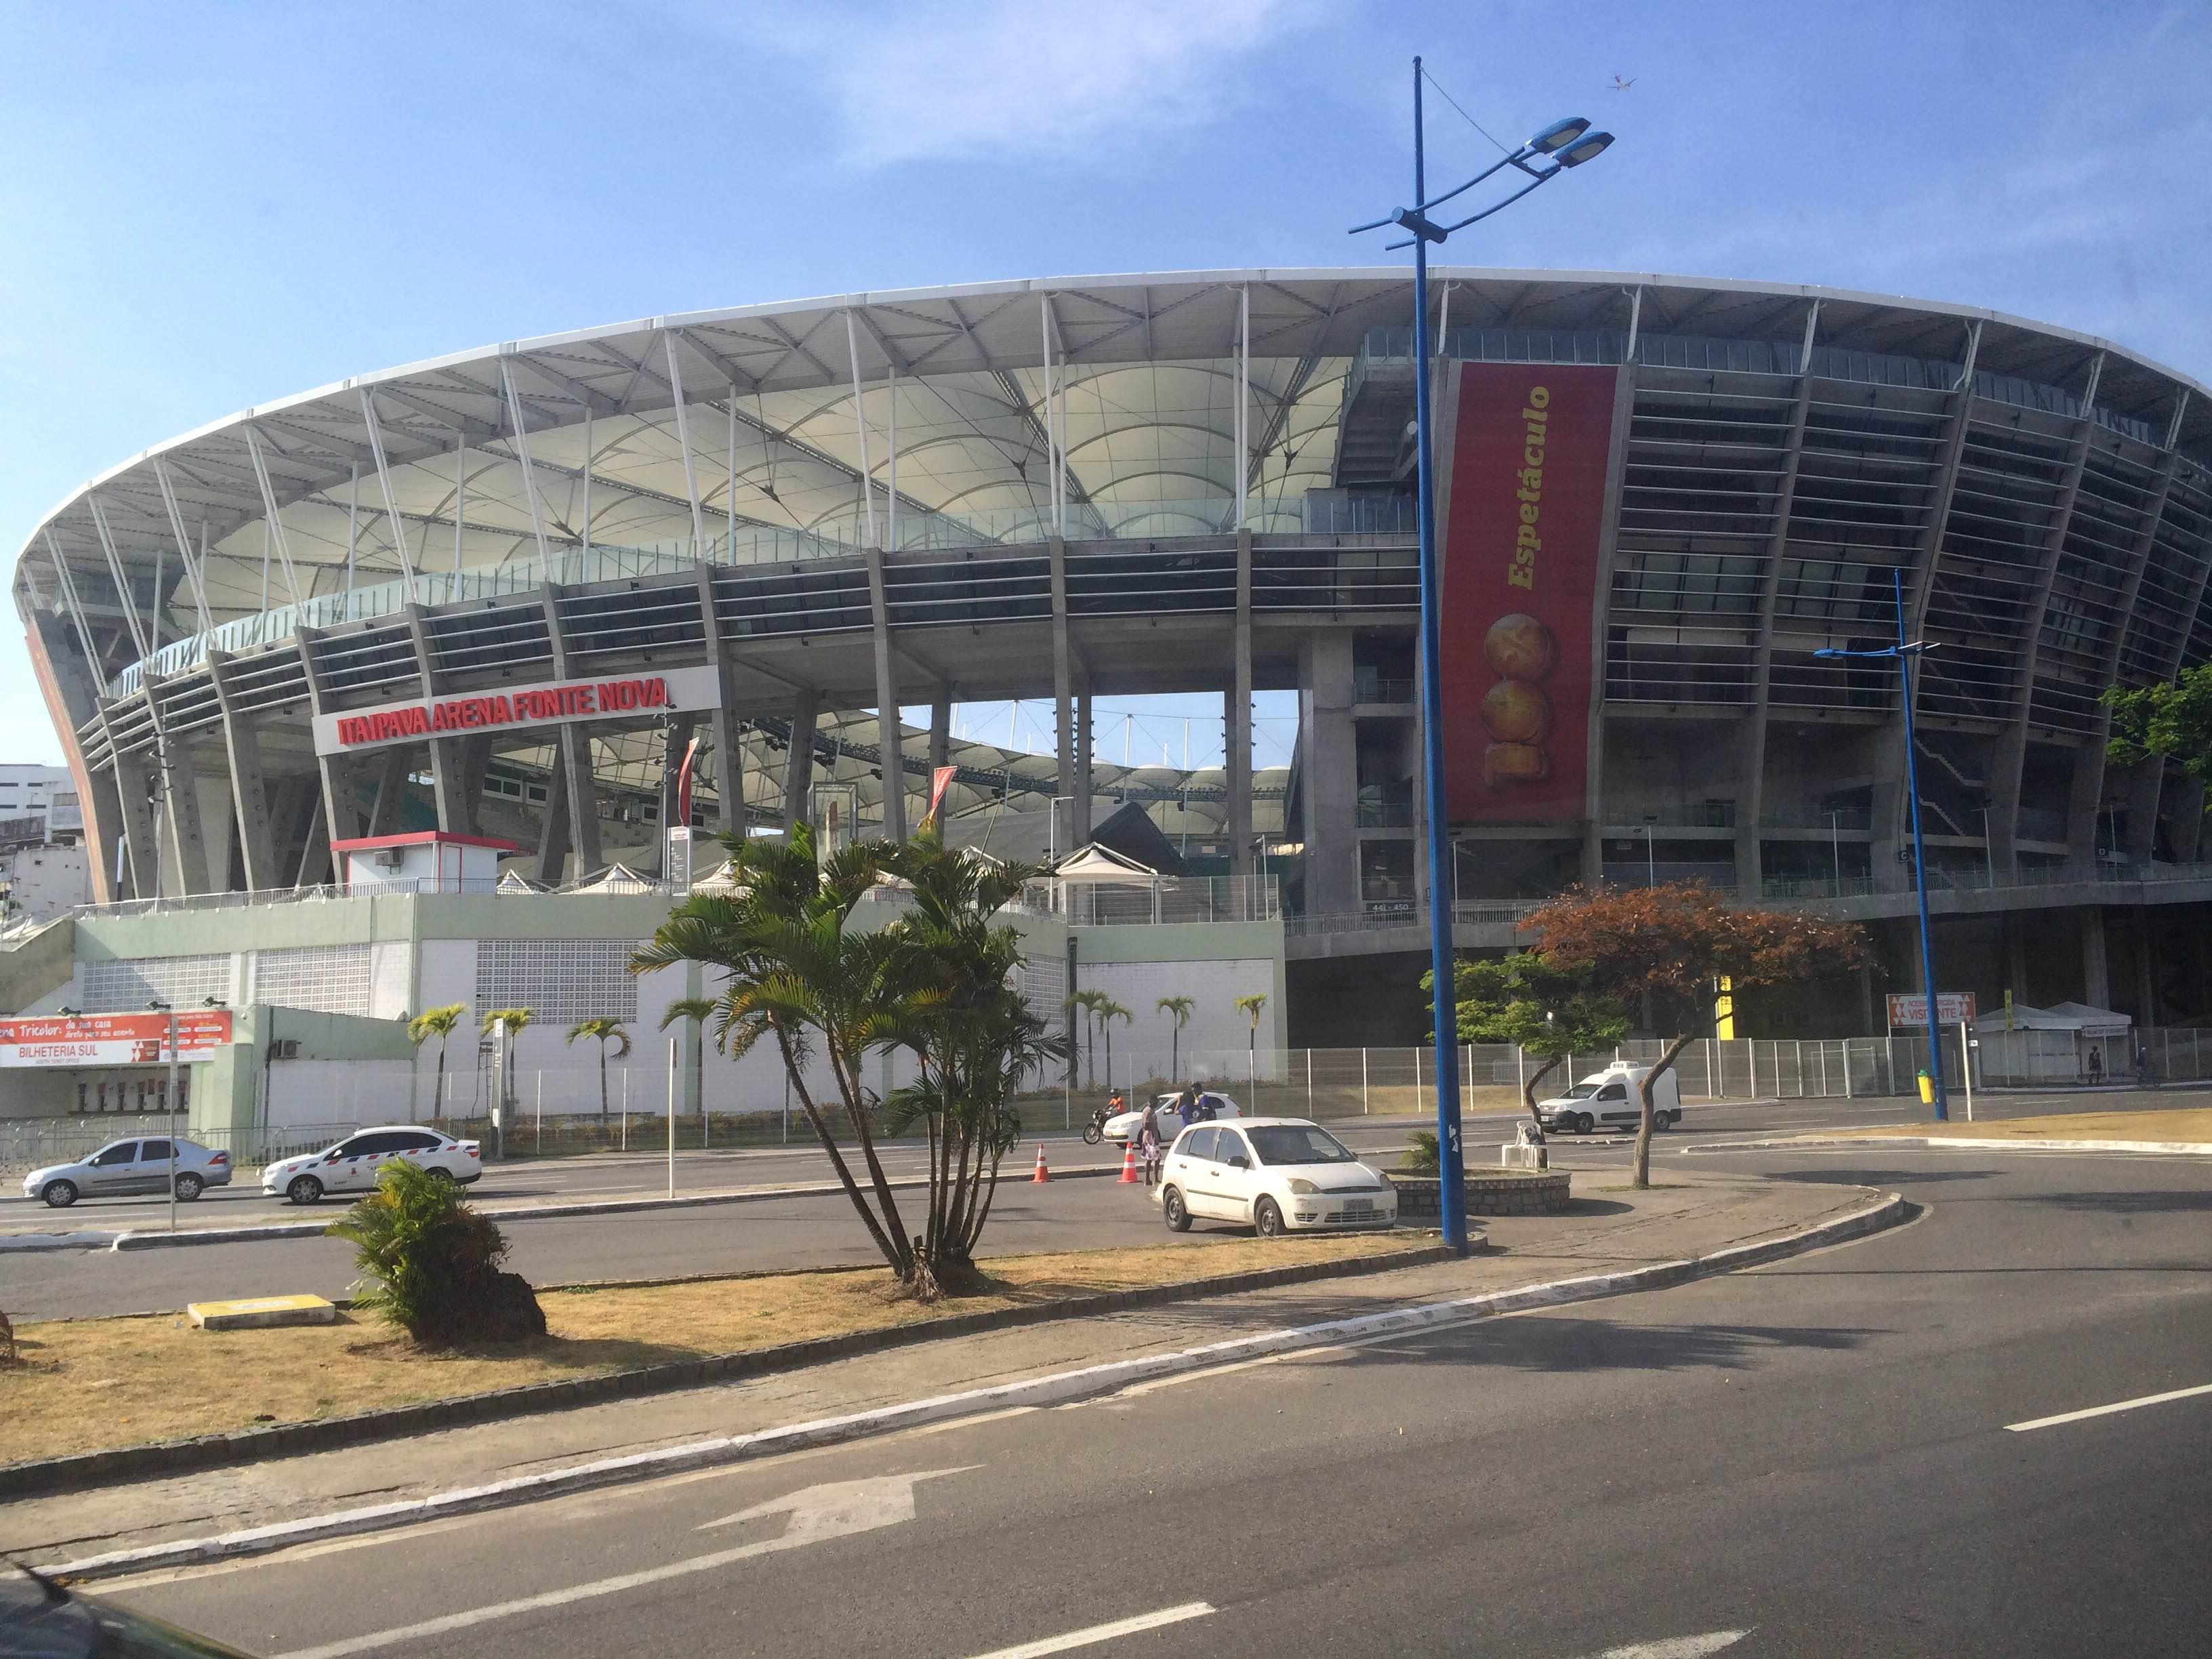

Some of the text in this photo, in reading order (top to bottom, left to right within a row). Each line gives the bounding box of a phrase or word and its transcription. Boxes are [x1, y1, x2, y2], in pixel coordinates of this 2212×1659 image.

[1508, 386, 1550, 591] Espetáculo
[336, 678, 670, 745] ITAIPAVA ARENA FONTE NOVA
[1901, 851, 1908, 860] C
[19, 1023, 62, 1038] Tricolor:
[19, 1044, 98, 1058] BILHETERIA SUL
